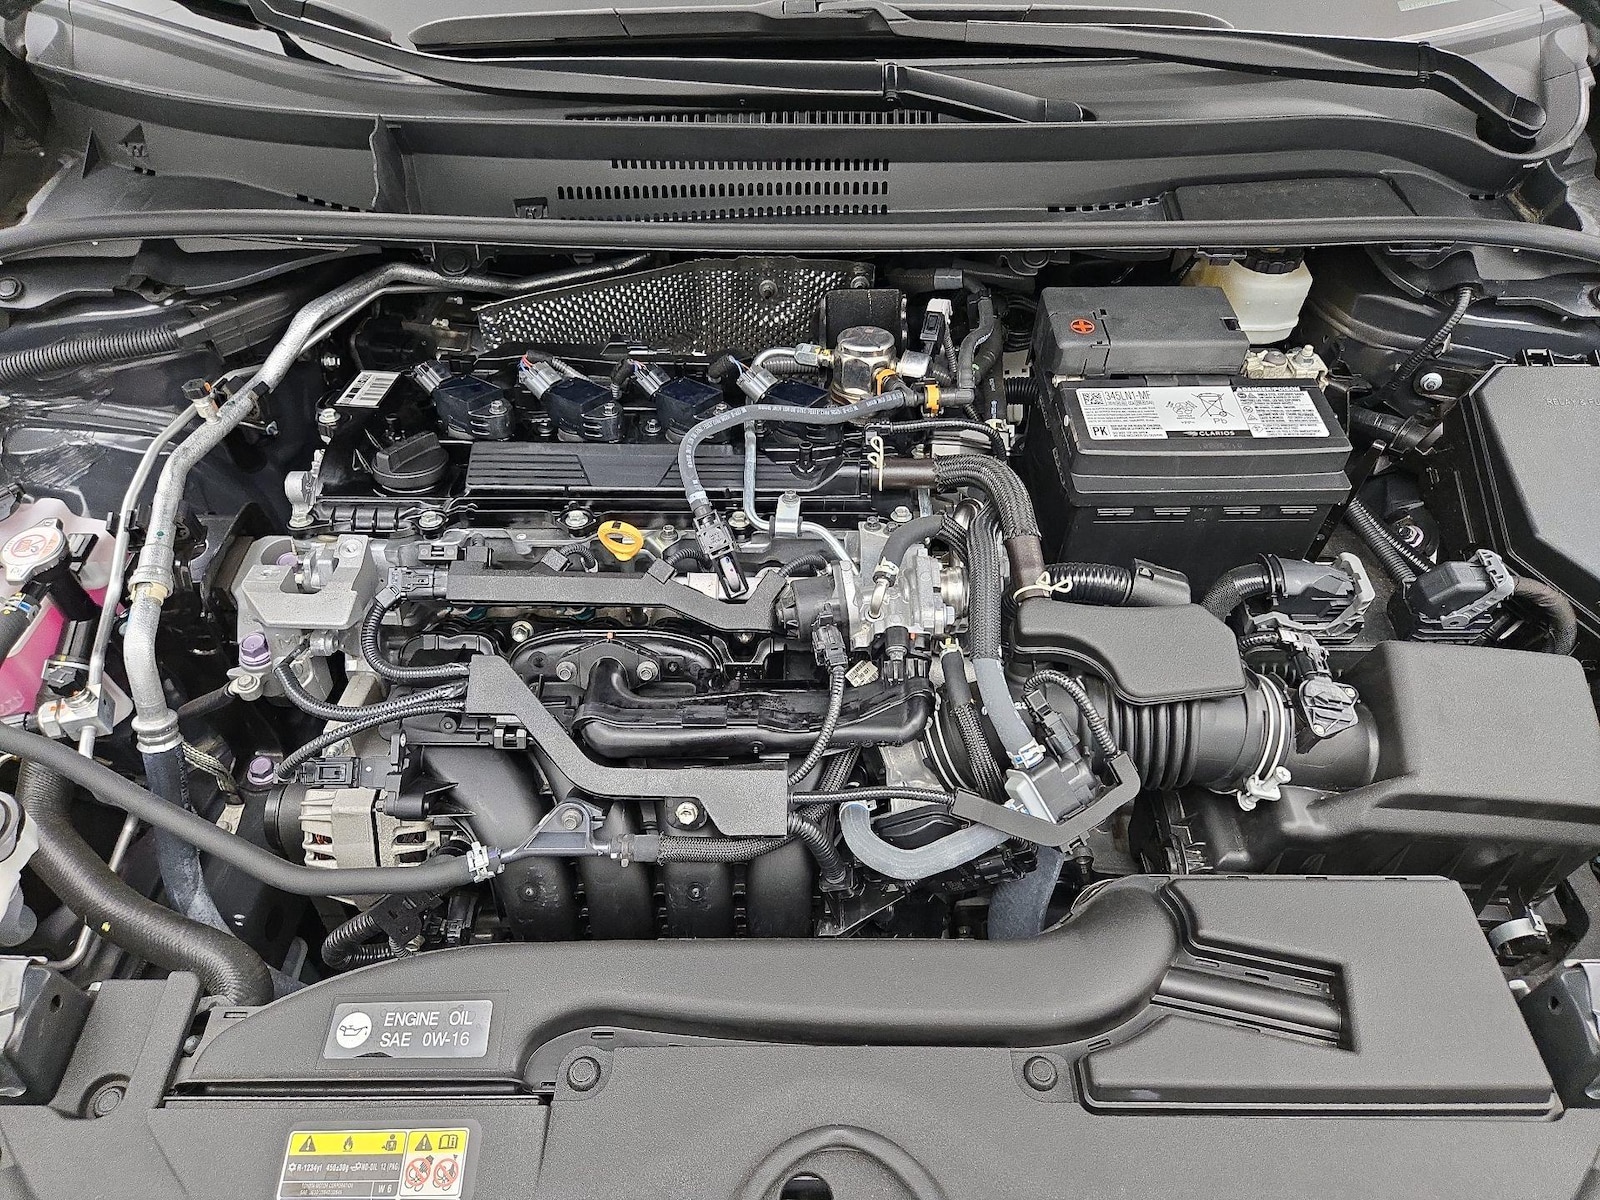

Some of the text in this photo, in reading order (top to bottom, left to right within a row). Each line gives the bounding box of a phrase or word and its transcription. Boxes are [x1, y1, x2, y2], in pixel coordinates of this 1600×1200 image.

[1105, 390, 1151, 401] 345LN1-MF
[1213, 417, 1228, 425] Pb
[1092, 426, 1108, 436] PK
[384, 1010, 473, 1027] ENGINE OIL
[379, 1031, 470, 1048] SAE 0W-16
[380, 1162, 387, 1172] 12
[378, 1184, 393, 1193] W 6
